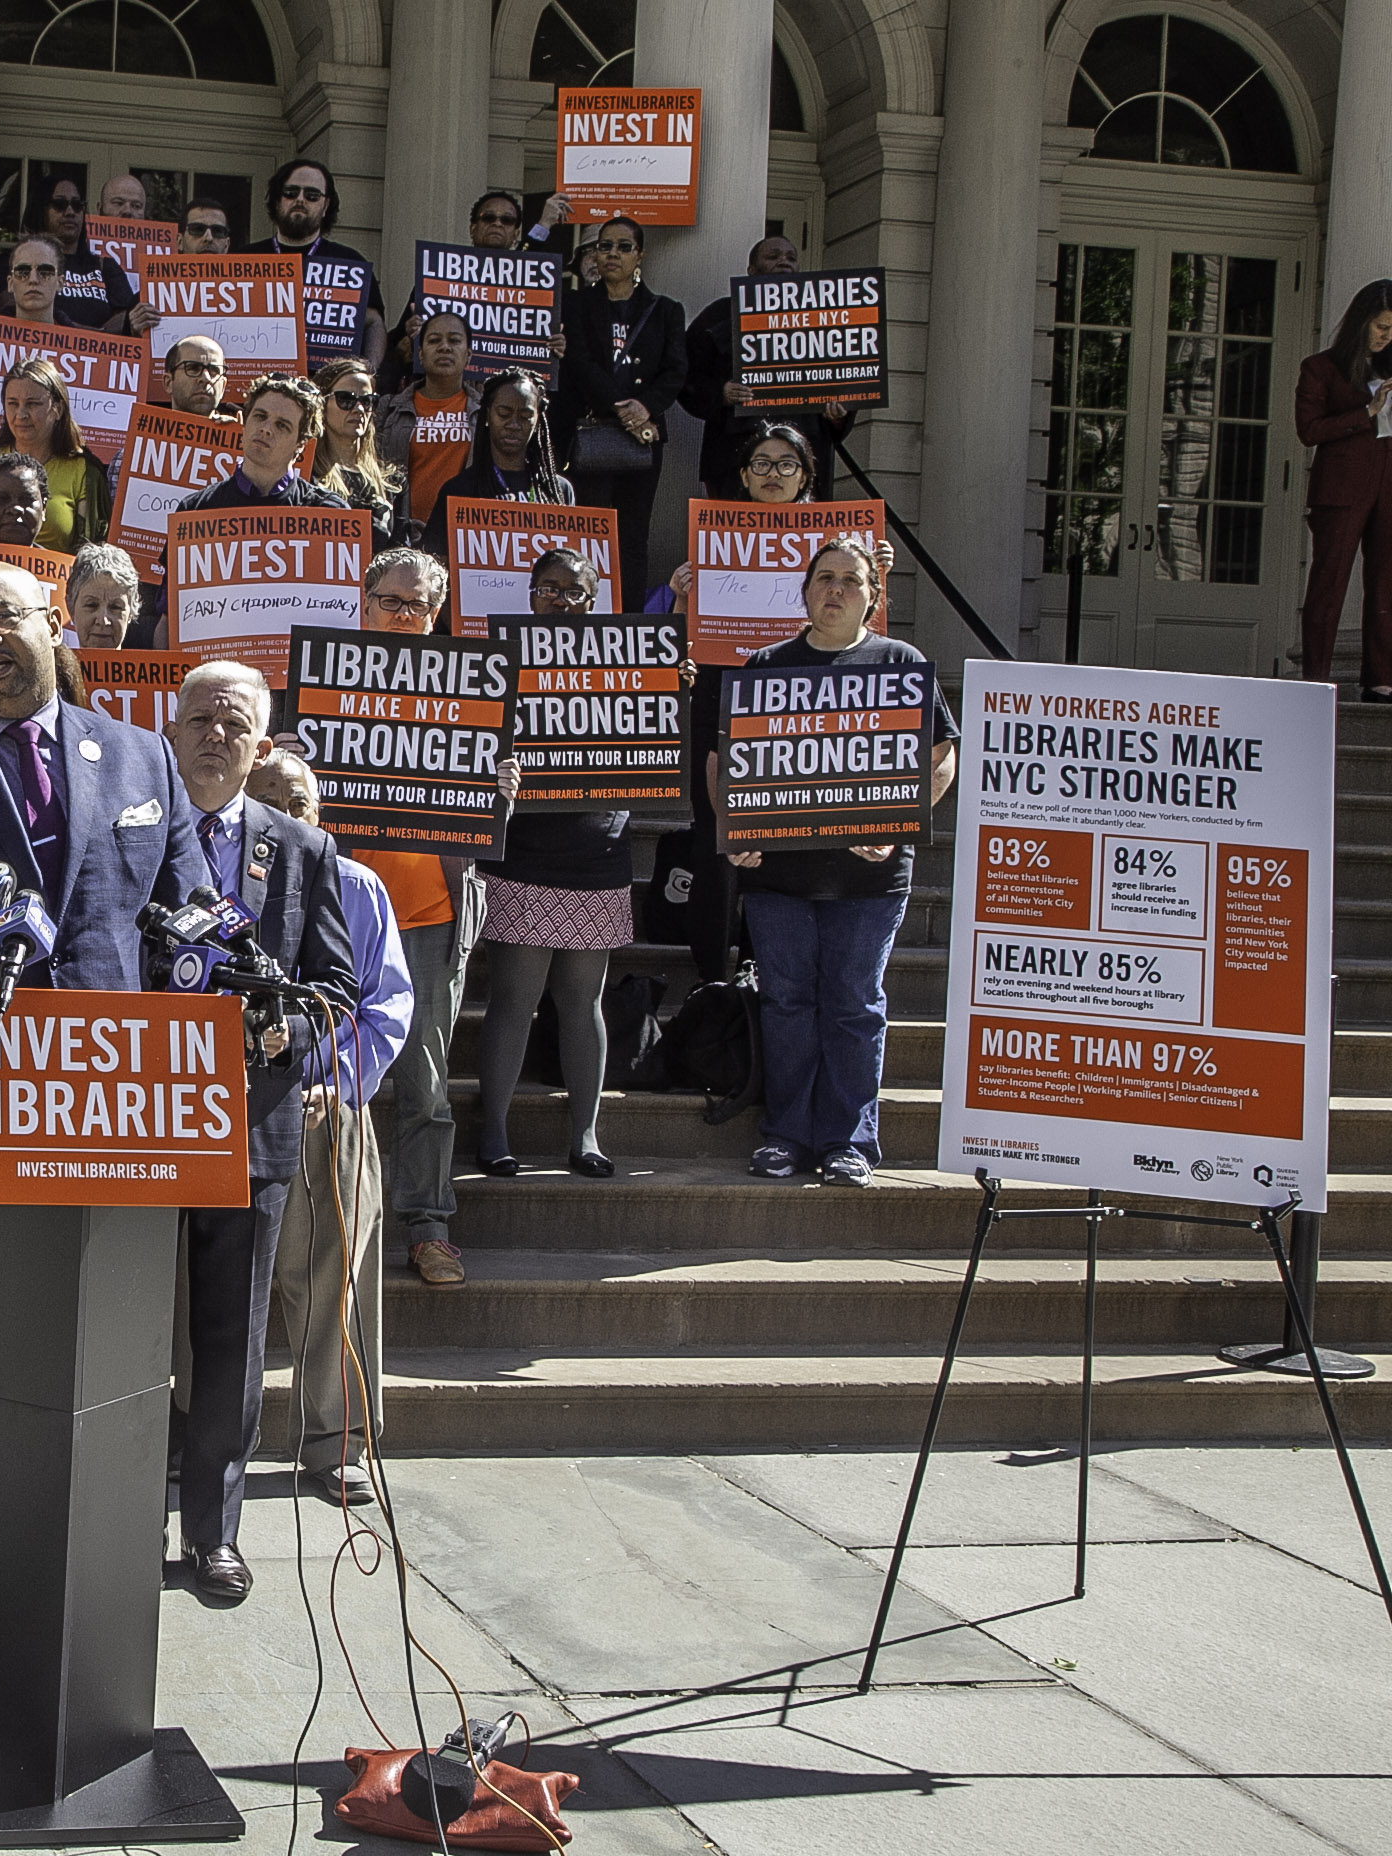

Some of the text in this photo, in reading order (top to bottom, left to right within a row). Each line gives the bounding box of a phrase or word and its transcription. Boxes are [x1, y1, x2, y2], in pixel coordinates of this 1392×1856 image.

[564, 94, 695, 110] #INVESTINLIBRARIES
[563, 113, 693, 145] INVEST IN
[576, 154, 658, 170] Community
[146, 261, 295, 279] #INVESTINLIBRARIES
[147, 281, 295, 314] INVEST IN
[738, 276, 879, 313] LIBRARIES
[767, 309, 849, 329] MAKE NYC
[206, 320, 290, 353] Thought
[740, 327, 879, 363] STRONGER
[741, 365, 879, 385] STAND WITH YOUR LIBRARY
[177, 516, 361, 540] #INVESTINLIBRARIES
[177, 540, 360, 585] INVEST IN
[182, 596, 359, 622] EARLY CHILDHOOD LITERACY
[731, 673, 924, 715] LIBRARIES
[984, 691, 1221, 728] NEW YORKERS AGREE
[767, 712, 881, 735] MAKE NYC
[729, 735, 919, 780] STRONGER
[982, 720, 1263, 773] LIBRARIES MAKE
[728, 785, 920, 808] STAND WITH YOUR LIBRARY
[980, 760, 1238, 811] NYC STRONGER
[728, 823, 920, 840] #INVESTINLIBRARIES INVESTINLIBRARIES.ORG
[988, 837, 1050, 869] 93%
[1114, 846, 1177, 879] 84%
[988, 870, 1079, 885] believe that libraries
[1227, 855, 1292, 888] 95%
[1010, 885, 1064, 896] cornerstone
[1111, 892, 1141, 902] should
[1143, 895, 1176, 905] receive
[1112, 881, 1176, 893] agree libraries
[210, 898, 232, 915] FOX
[985, 905, 1043, 917] communities
[986, 893, 1074, 909] of all New York City
[1111, 903, 1197, 919] increase in funding
[221, 908, 240, 925] 5
[985, 943, 1162, 985] NEARLY 85%
[170, 1019, 217, 1075] IN
[981, 1028, 1217, 1077] MORE THAN 97%
[16, 1161, 179, 1181] INVESTINLIBRARIES.ORG
